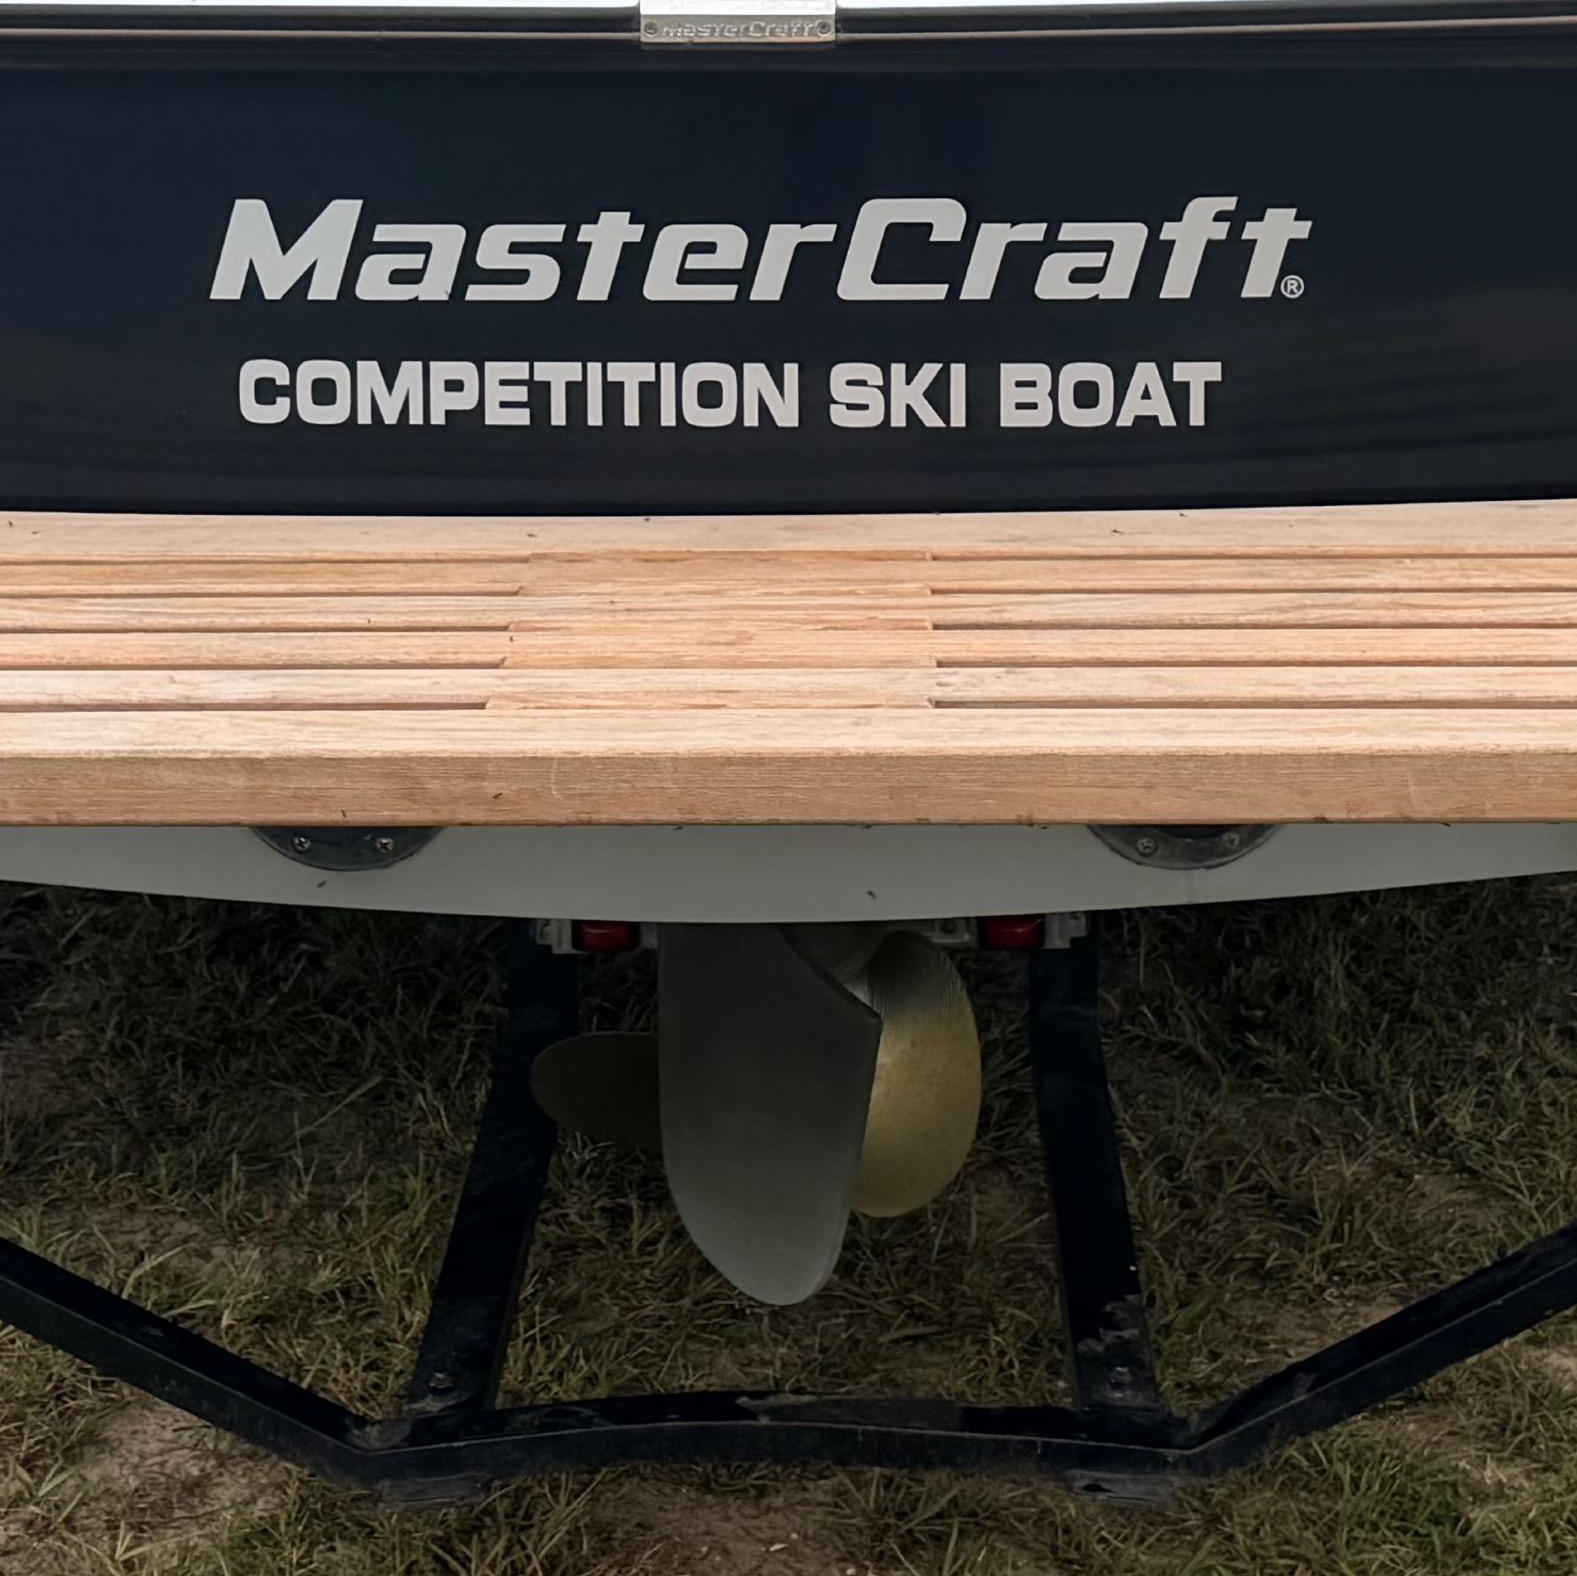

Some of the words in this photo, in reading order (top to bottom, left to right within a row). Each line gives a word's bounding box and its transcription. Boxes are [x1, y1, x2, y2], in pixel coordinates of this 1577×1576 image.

[238, 358, 799, 427] COMPETITION
[829, 362, 967, 428] SKI
[999, 361, 1222, 428] BOAT
